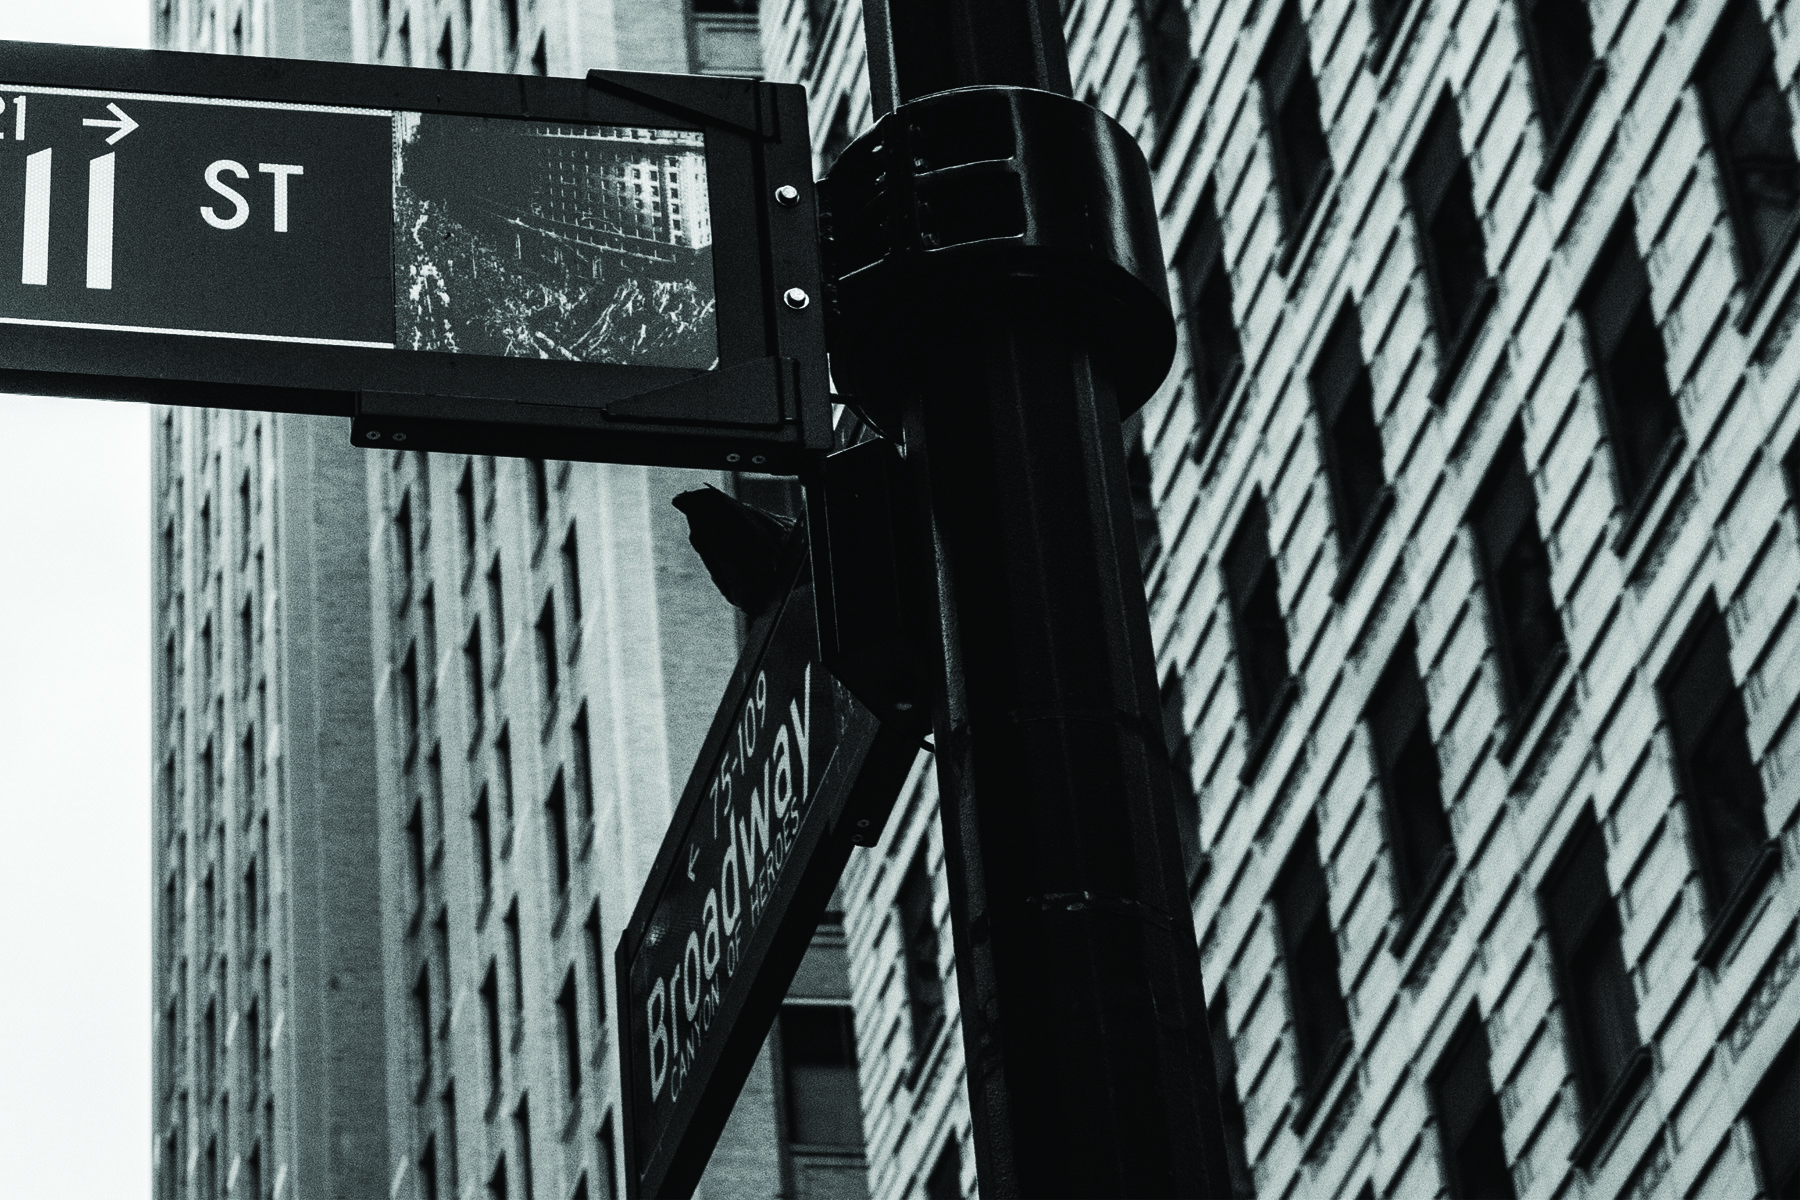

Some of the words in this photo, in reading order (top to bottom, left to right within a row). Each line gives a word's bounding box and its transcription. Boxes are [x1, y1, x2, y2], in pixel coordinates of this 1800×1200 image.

[200, 159, 304, 233] ST
[710, 669, 767, 840] 75-109
[646, 661, 811, 1103] Broadway
[670, 972, 720, 1103] CANYON
[727, 920, 742, 978] OF
[751, 796, 800, 928] HEROES
